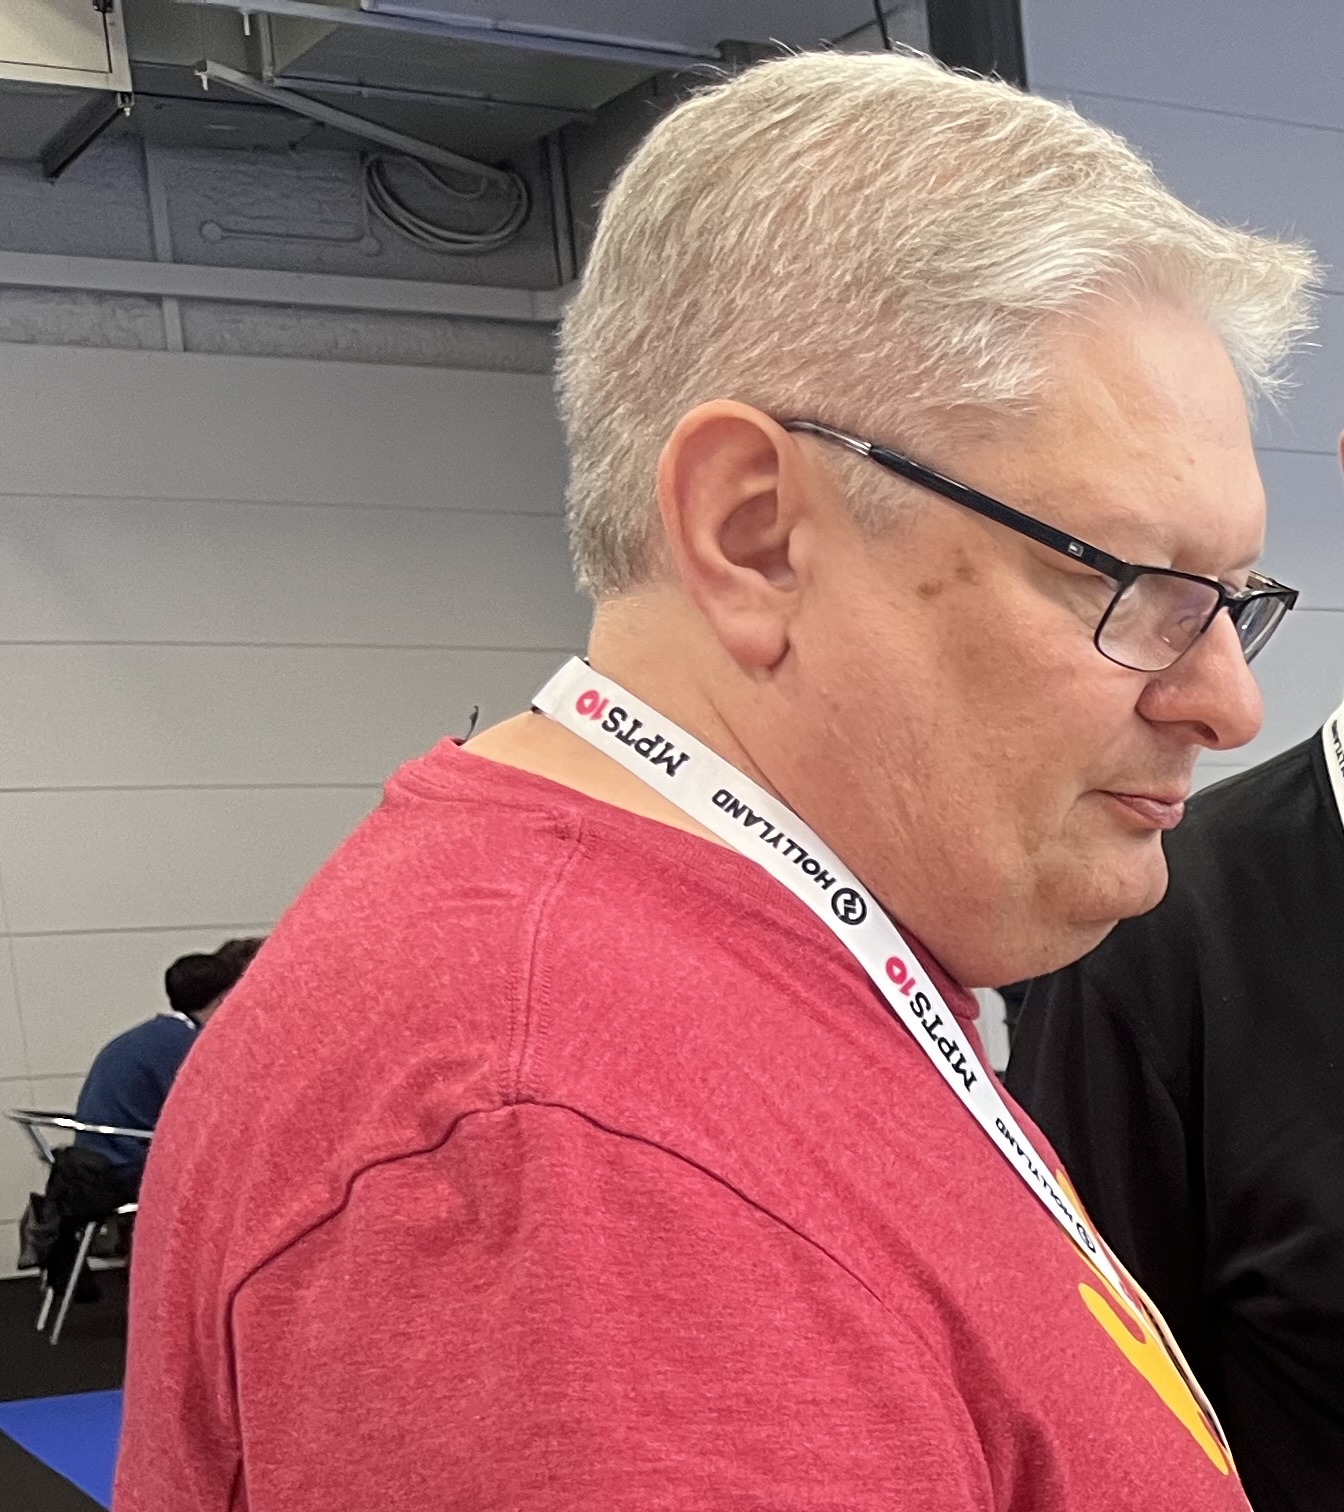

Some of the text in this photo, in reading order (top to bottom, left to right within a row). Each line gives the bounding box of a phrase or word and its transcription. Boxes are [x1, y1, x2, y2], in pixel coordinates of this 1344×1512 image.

[575, 689, 690, 777] MPTS10
[711, 788, 836, 890] HOLLYLAND
[885, 956, 977, 1093] MPTS10
